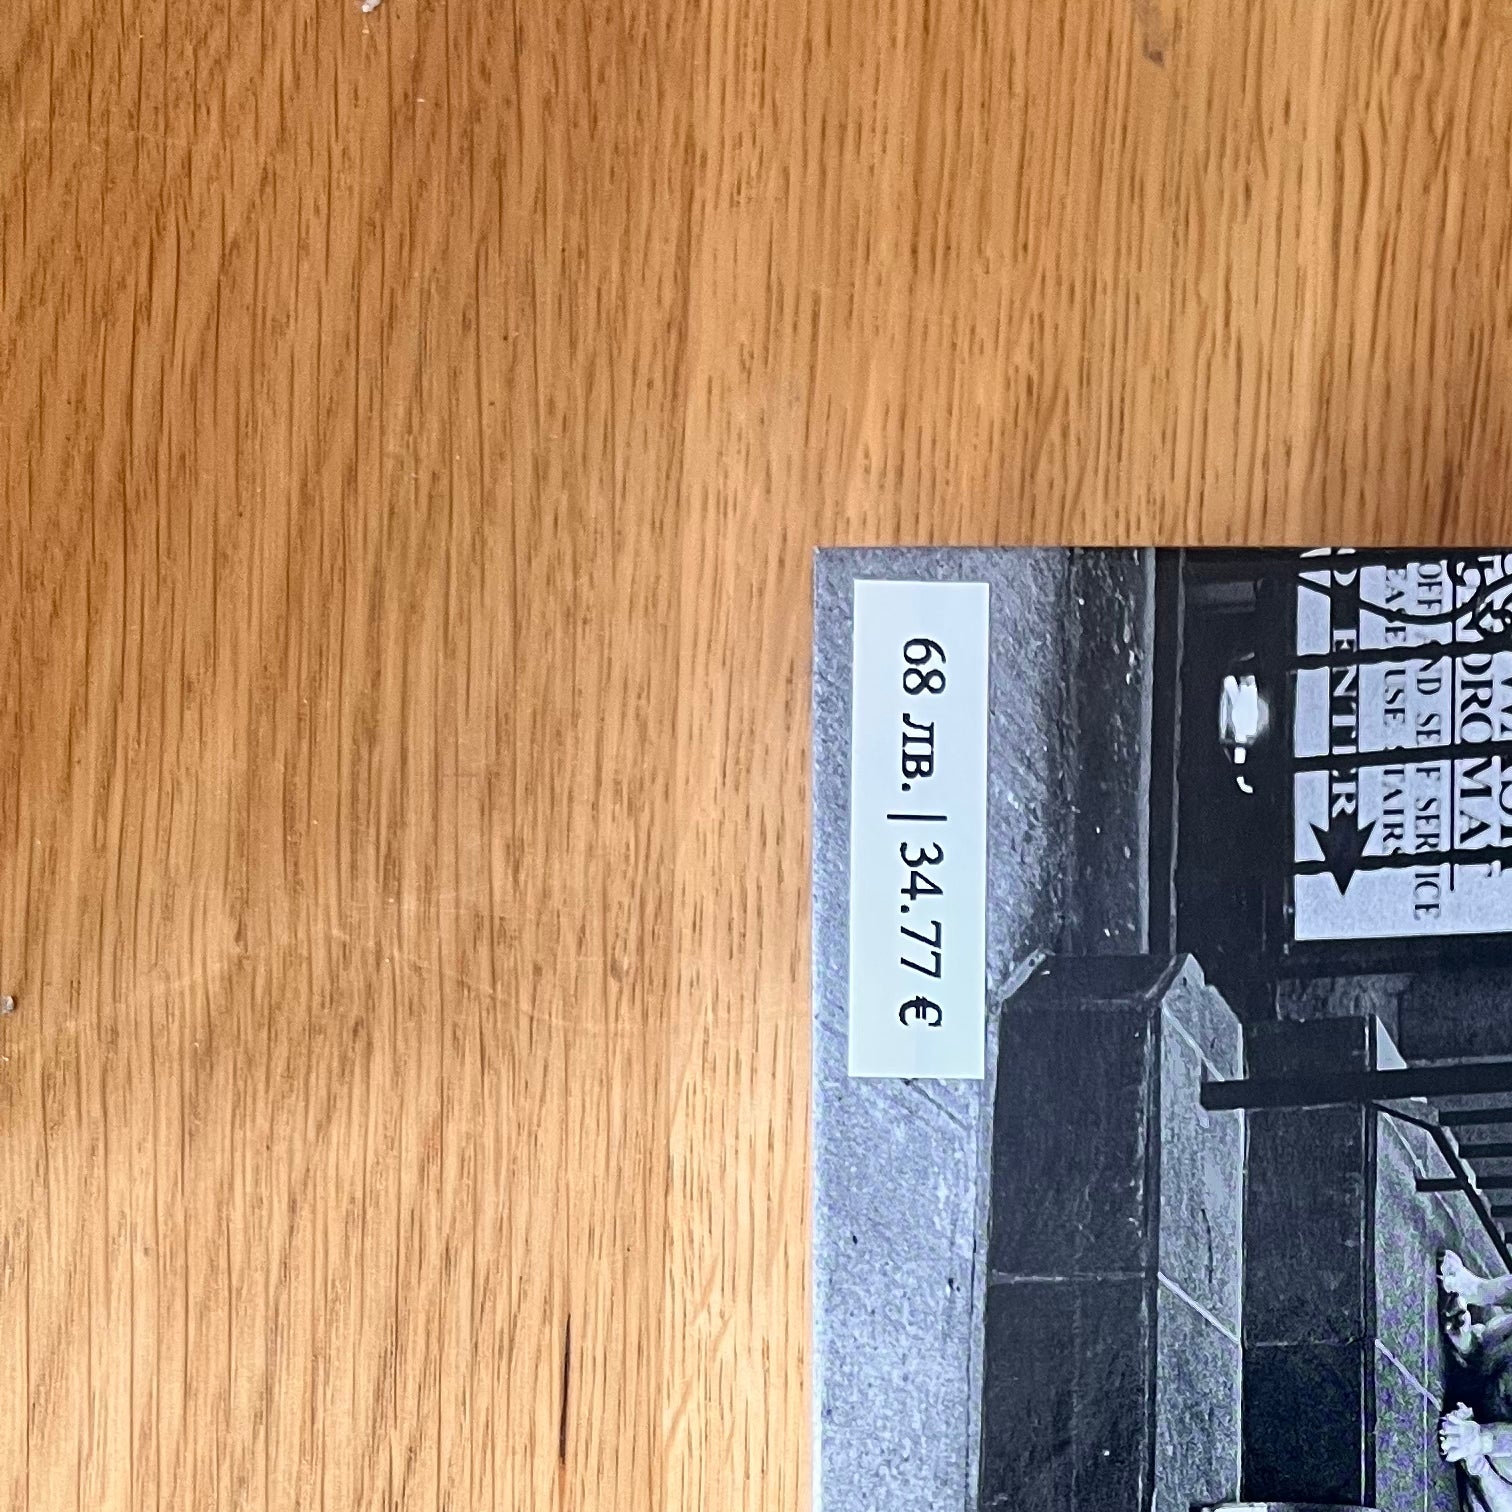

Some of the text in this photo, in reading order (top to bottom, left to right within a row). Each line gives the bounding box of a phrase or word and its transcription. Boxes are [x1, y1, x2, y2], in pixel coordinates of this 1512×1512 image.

[902, 637, 947, 696] 68
[1416, 633, 1442, 696] ND
[1383, 668, 1407, 727] USE
[901, 712, 936, 793] лв.
[1415, 713, 1442, 780] SEF
[1414, 797, 1441, 921] SERICE
[899, 841, 944, 980] 34.77
[898, 996, 943, 1028] €
